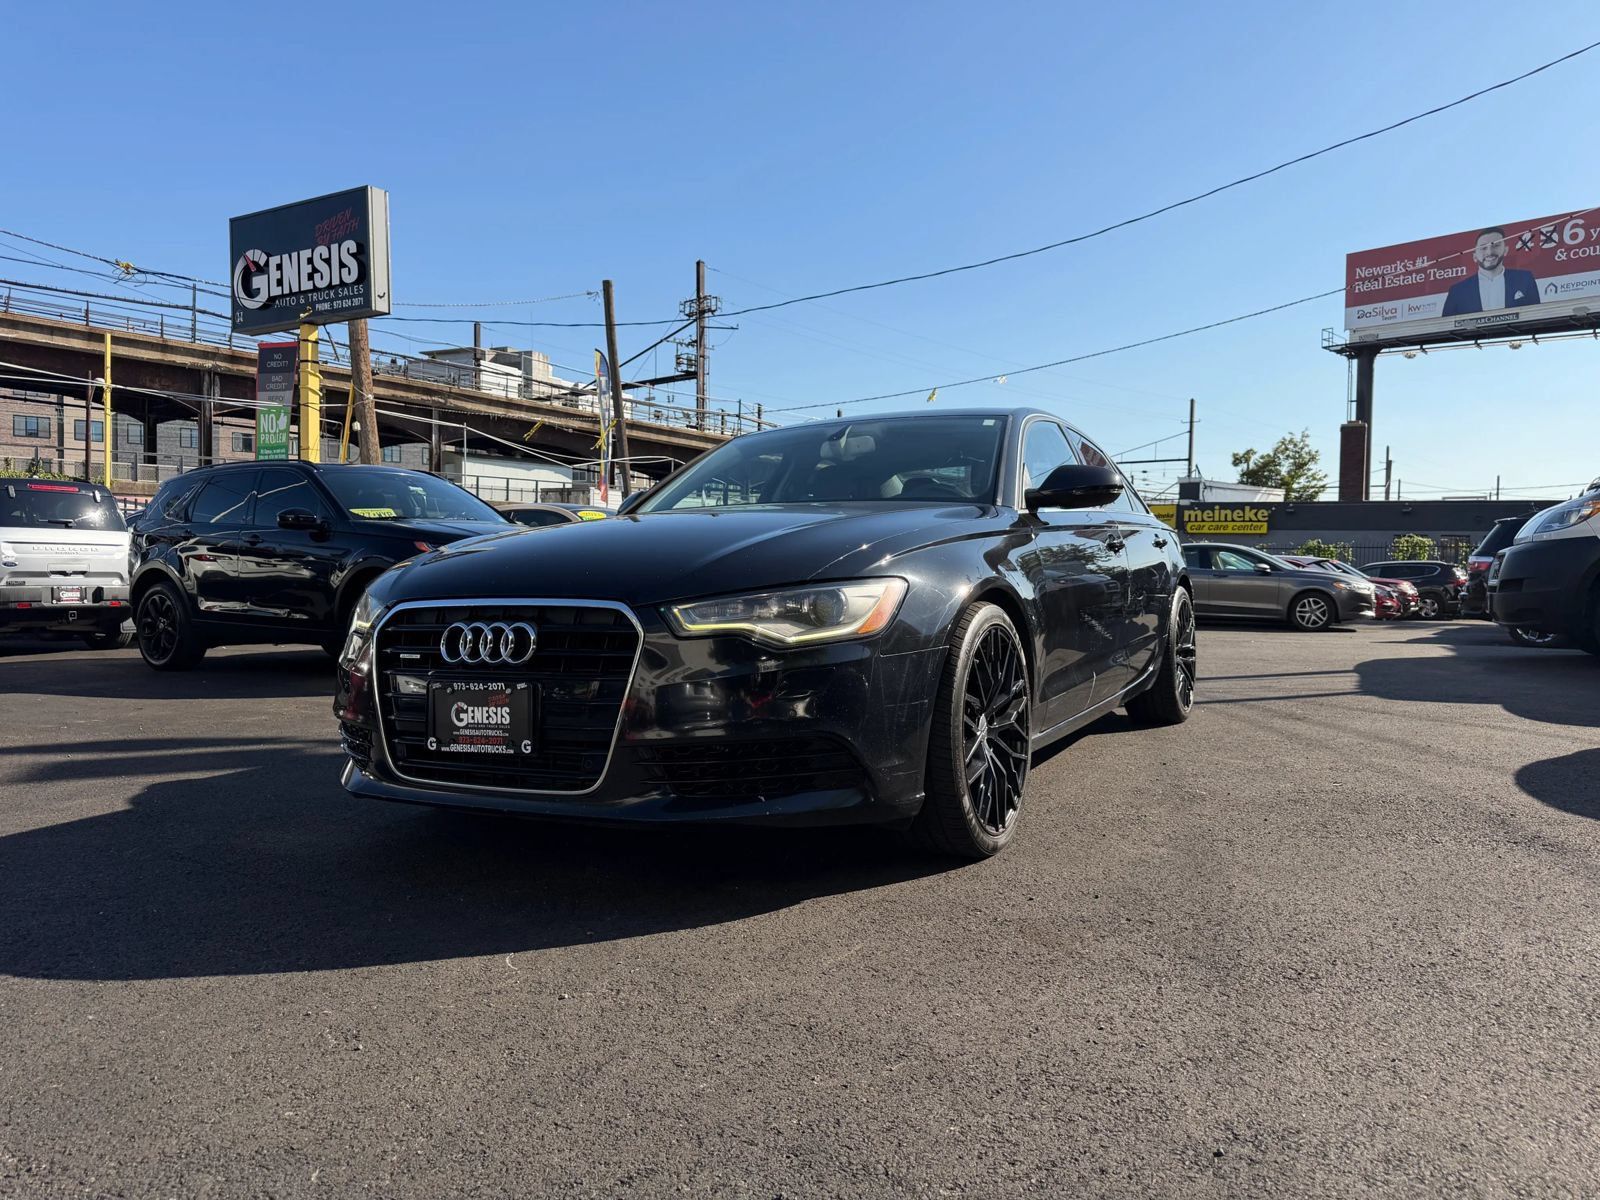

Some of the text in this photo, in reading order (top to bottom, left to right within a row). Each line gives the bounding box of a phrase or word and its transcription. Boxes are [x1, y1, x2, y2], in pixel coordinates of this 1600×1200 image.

[315, 208, 352, 236] DRIVEN
[332, 218, 359, 240] FAITH
[1563, 218, 1586, 245] 6
[1554, 248, 1568, 261] &
[233, 240, 359, 310] GENESIS
[1355, 256, 1429, 279] Newark's #1
[1354, 266, 1467, 293] Real Estate Team
[274, 284, 364, 308] AUTO & TRUCK SALES
[315, 297, 364, 312] PHONE: 973 624 2071
[1357, 304, 1398, 319] DaSilva
[266, 360, 289, 368] CREDIT?
[1184, 505, 1269, 522] meineke
[1189, 522, 1264, 531] car care center
[453, 682, 506, 690] 973-624-2071
[450, 701, 511, 727] GENESIS
[427, 736, 437, 750] G
[459, 736, 503, 744] 973-624-2071
[521, 740, 531, 753] G
